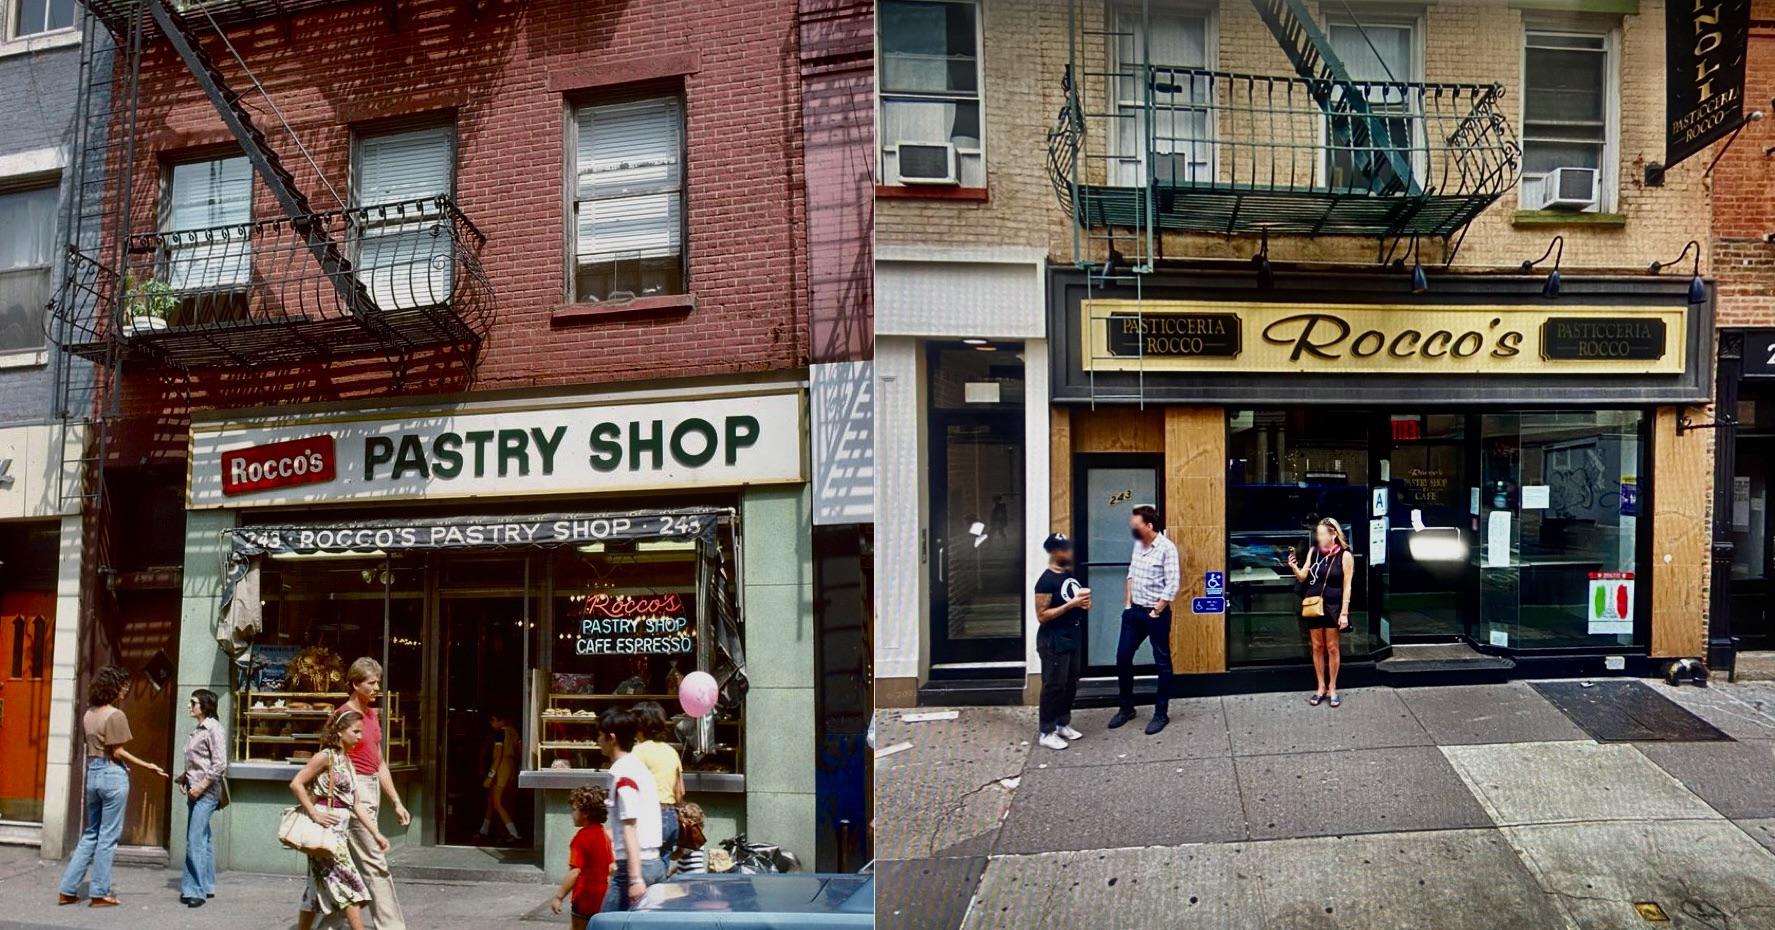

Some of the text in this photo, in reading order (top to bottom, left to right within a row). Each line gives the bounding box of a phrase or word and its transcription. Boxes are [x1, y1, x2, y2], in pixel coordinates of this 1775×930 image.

[1686, 111, 1725, 143] ROCCO
[1122, 318, 1226, 334] PASTICCERIA
[1557, 323, 1651, 339] PASTICCERIA
[1147, 338, 1203, 353] ROCCO
[1262, 313, 1524, 362] Rocco's
[1578, 341, 1630, 356] ROCCO
[364, 425, 568, 482] PASTRY
[589, 415, 760, 472] SHOP
[1109, 490, 1132, 505] 243
[1376, 492, 1384, 509] A
[245, 516, 701, 549] 243 ROCCO'S PASTRY SHOP 243
[586, 593, 682, 617] Rocco's
[582, 617, 687, 634] PASTRY SHOP
[576, 637, 692, 654] CAFE ESPRESSO
